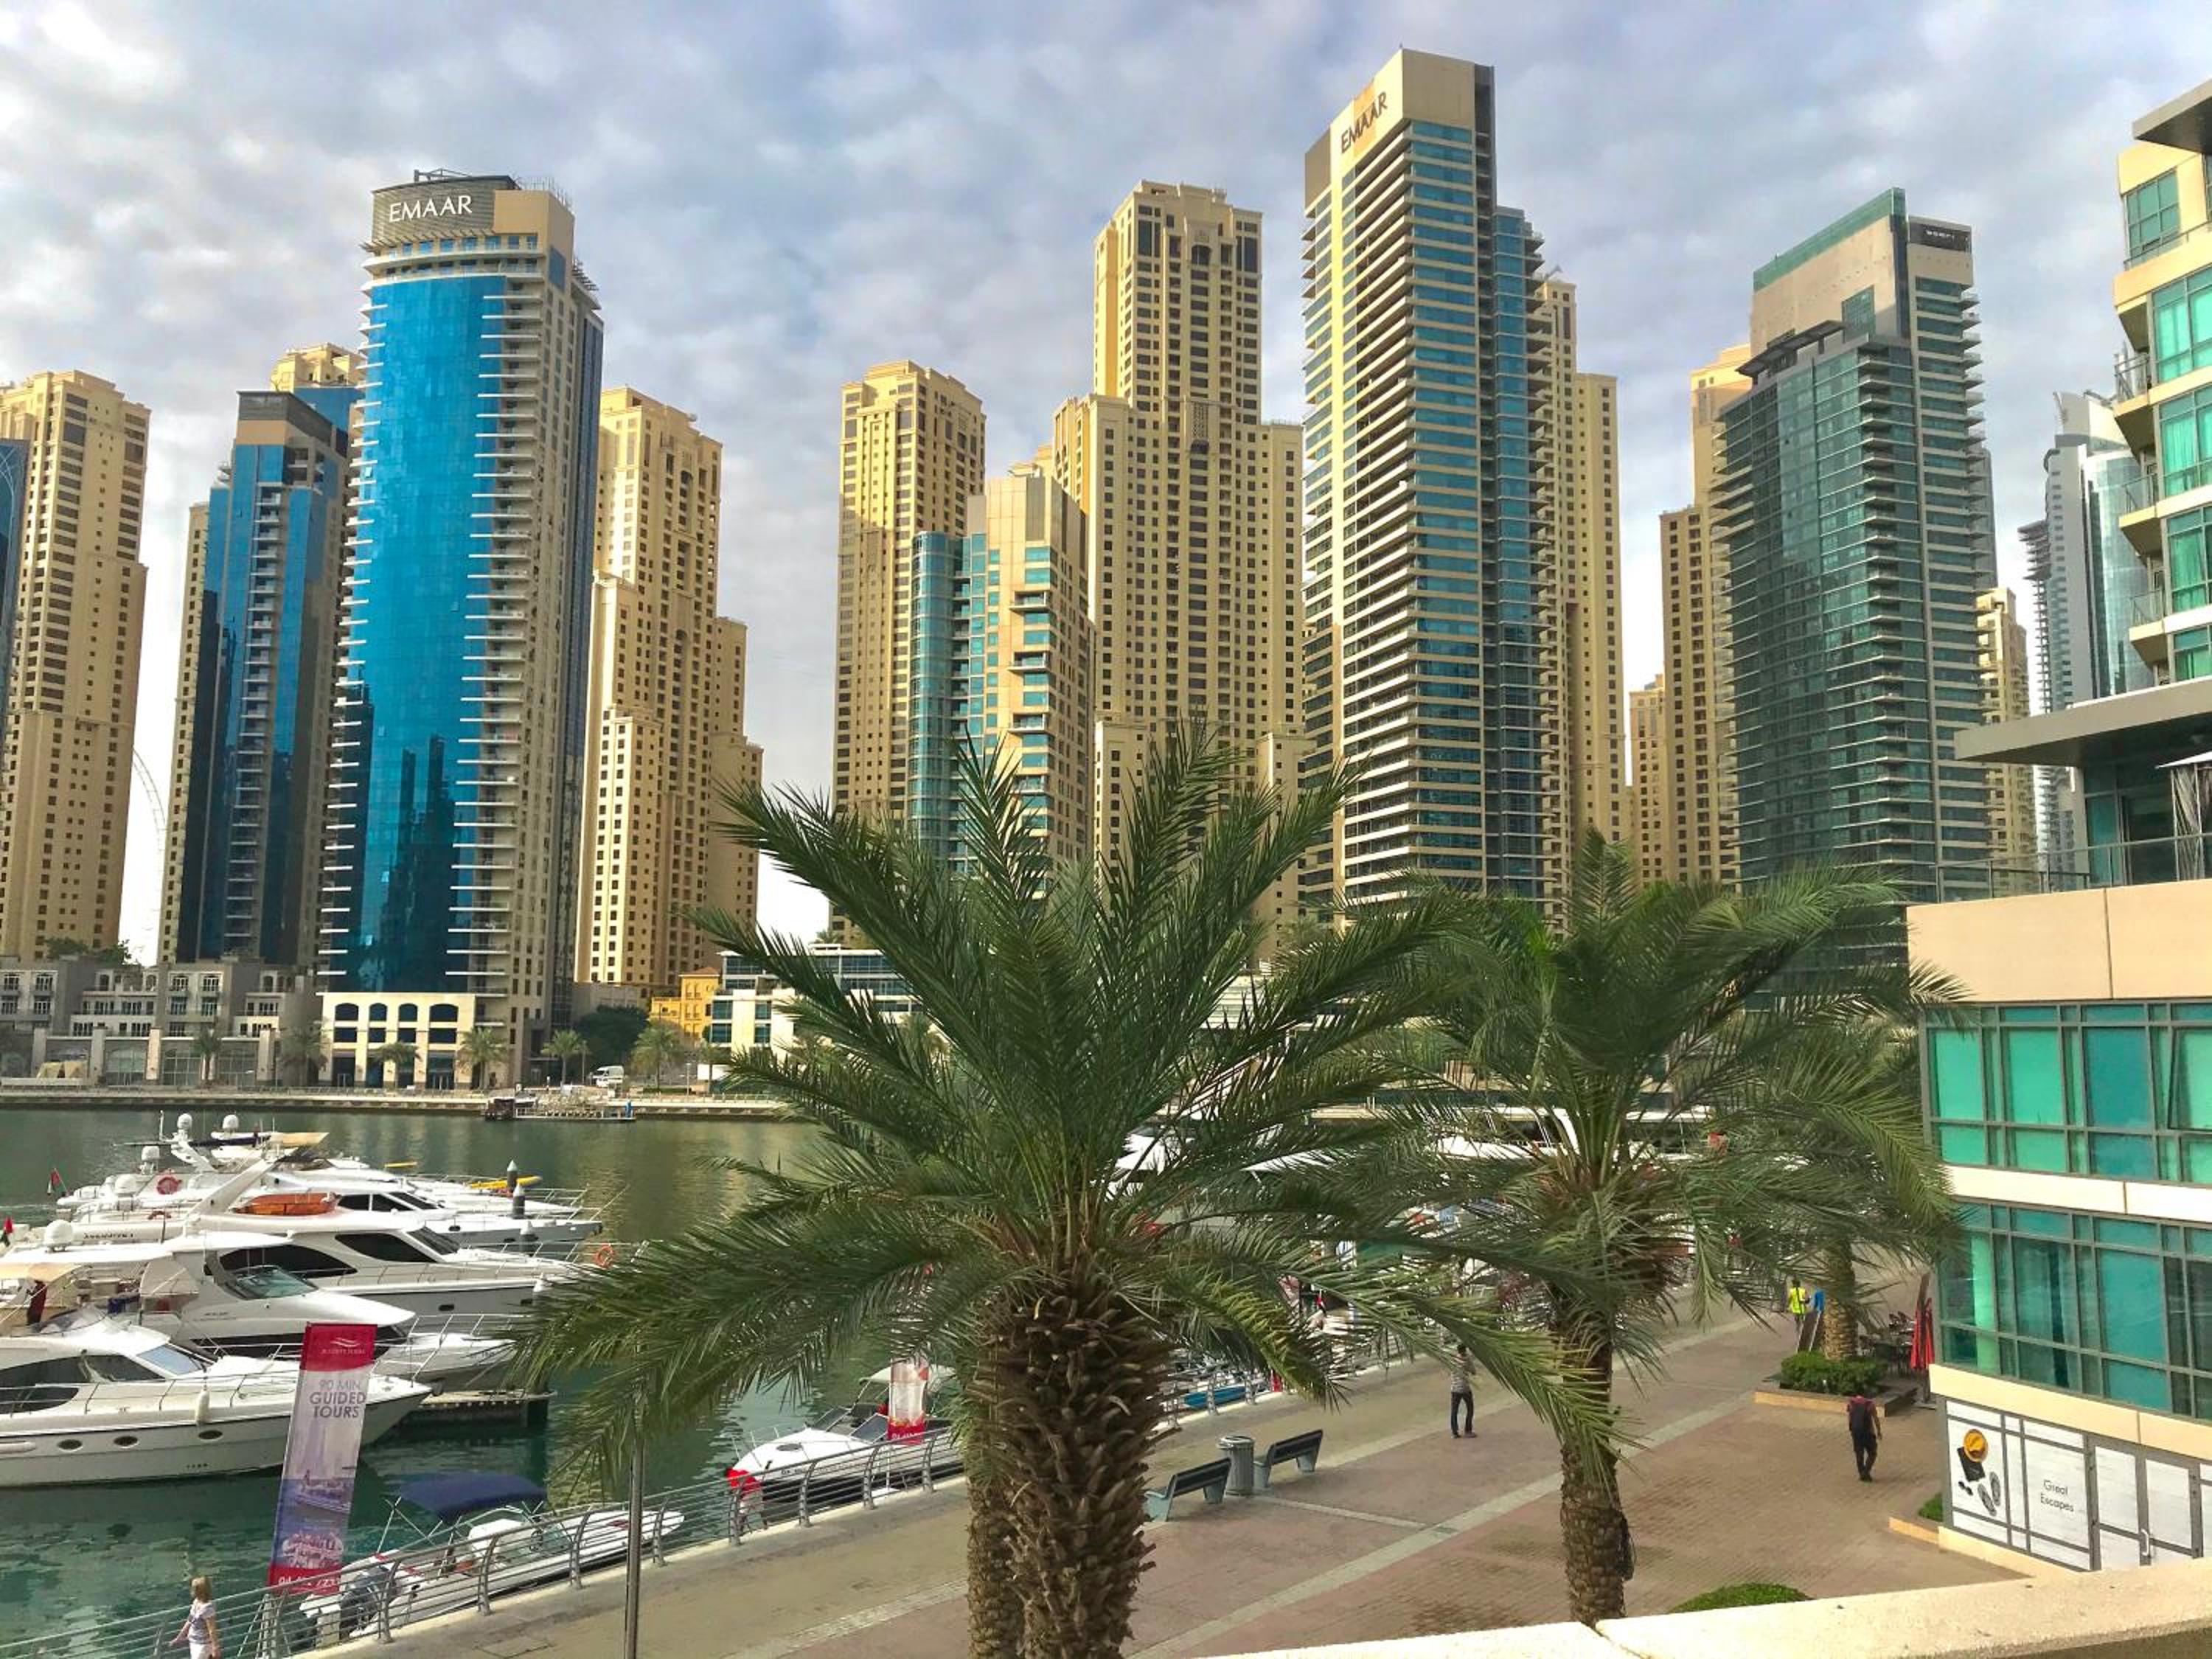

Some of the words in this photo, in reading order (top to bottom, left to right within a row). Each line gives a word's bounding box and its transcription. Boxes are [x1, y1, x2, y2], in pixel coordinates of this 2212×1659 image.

[1341, 91, 1388, 153] EMAAR
[389, 195, 473, 222] EMAAR
[336, 1380, 361, 1390] MIN
[310, 1391, 366, 1405] GUIDED
[313, 1405, 360, 1418] TOURS
[2043, 1479, 2068, 1495] Great
[2040, 1492, 2074, 1512] Escapes
